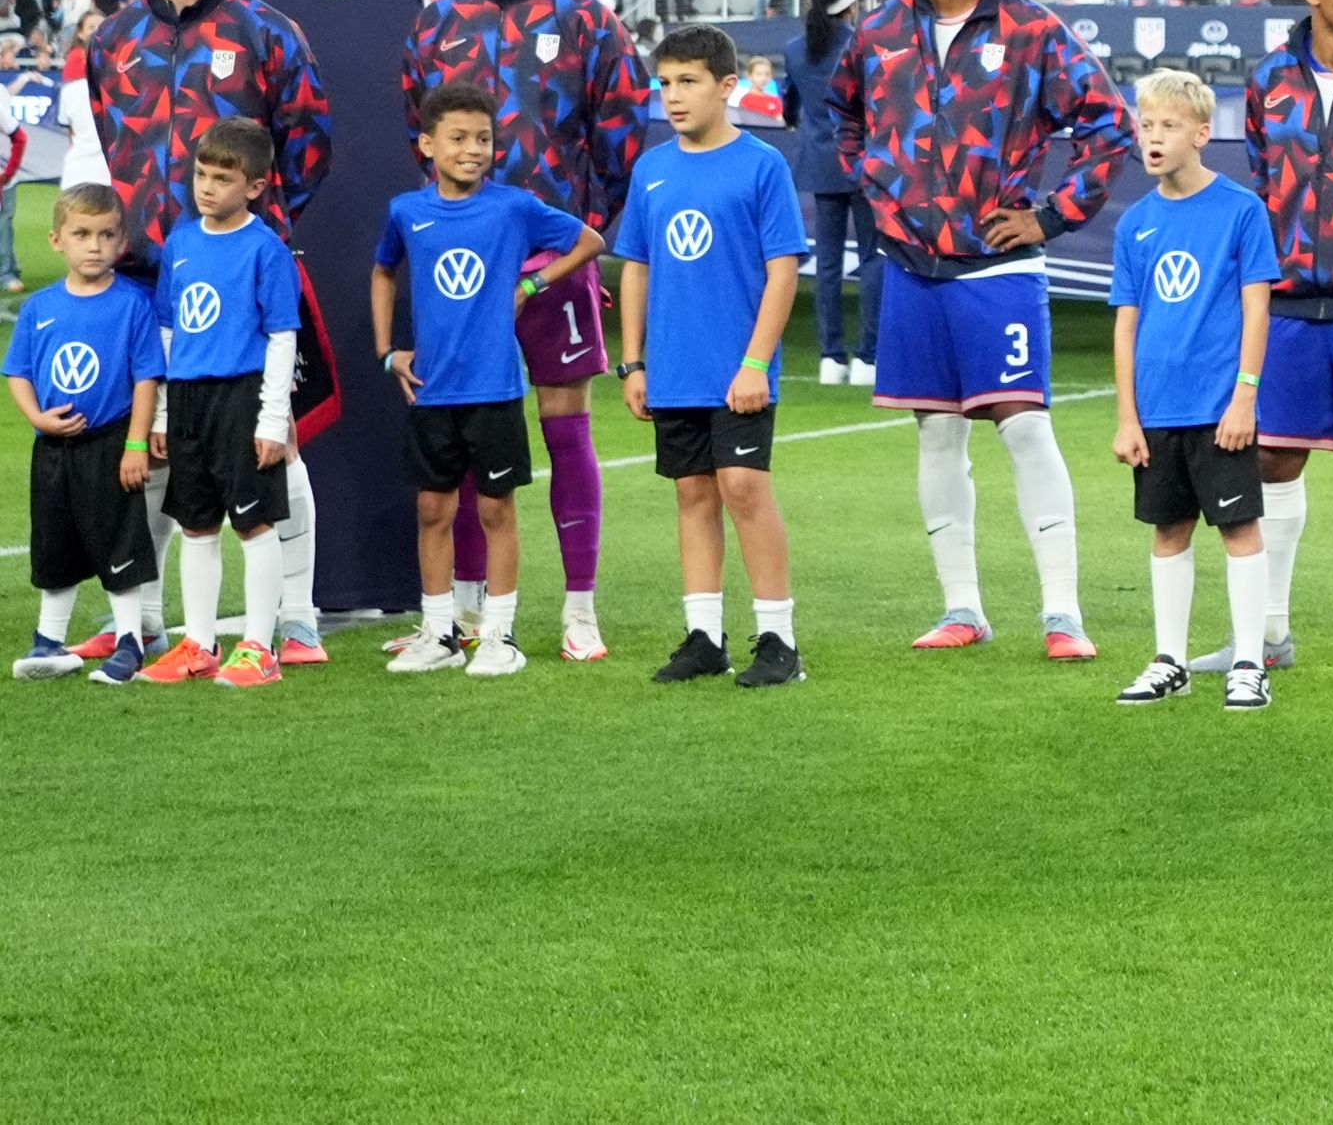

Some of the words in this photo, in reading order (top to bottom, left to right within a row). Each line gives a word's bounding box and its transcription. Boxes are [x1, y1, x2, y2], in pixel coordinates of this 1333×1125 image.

[215, 52, 234, 61] USA
[563, 301, 583, 345] 1
[1005, 323, 1029, 367] 3
